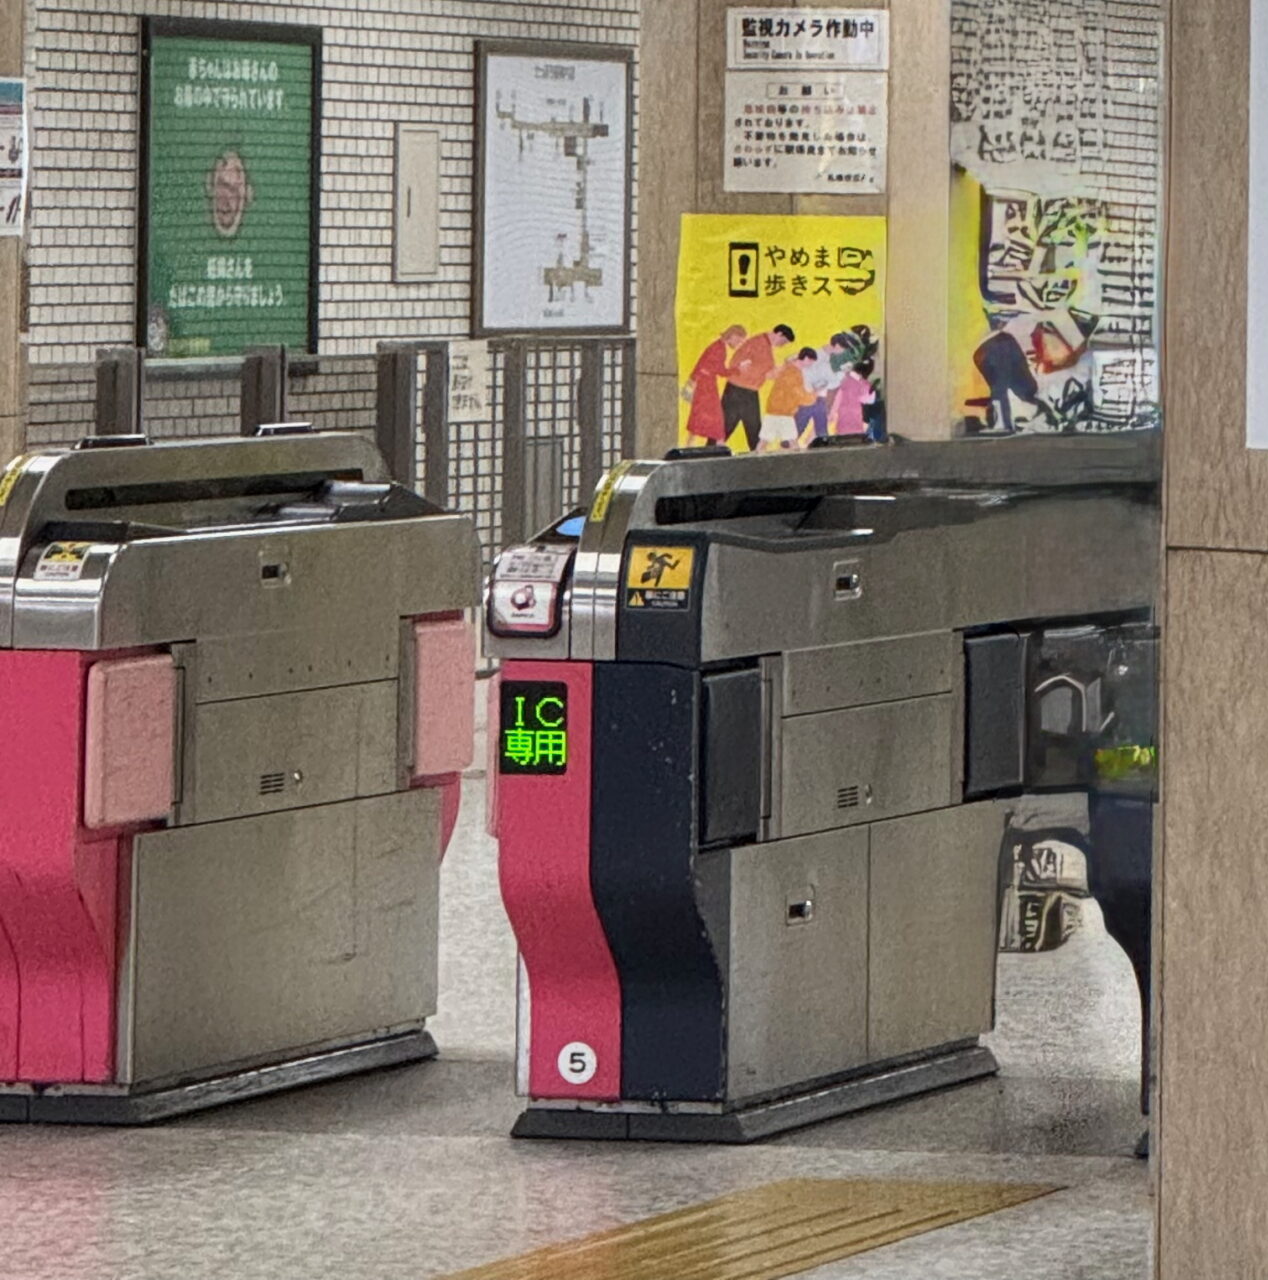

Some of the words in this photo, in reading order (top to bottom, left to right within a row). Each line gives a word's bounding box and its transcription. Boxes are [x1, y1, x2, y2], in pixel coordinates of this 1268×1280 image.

[514, 696, 564, 727] IC
[504, 728, 567, 766] 専用
[569, 1052, 586, 1073] 5
